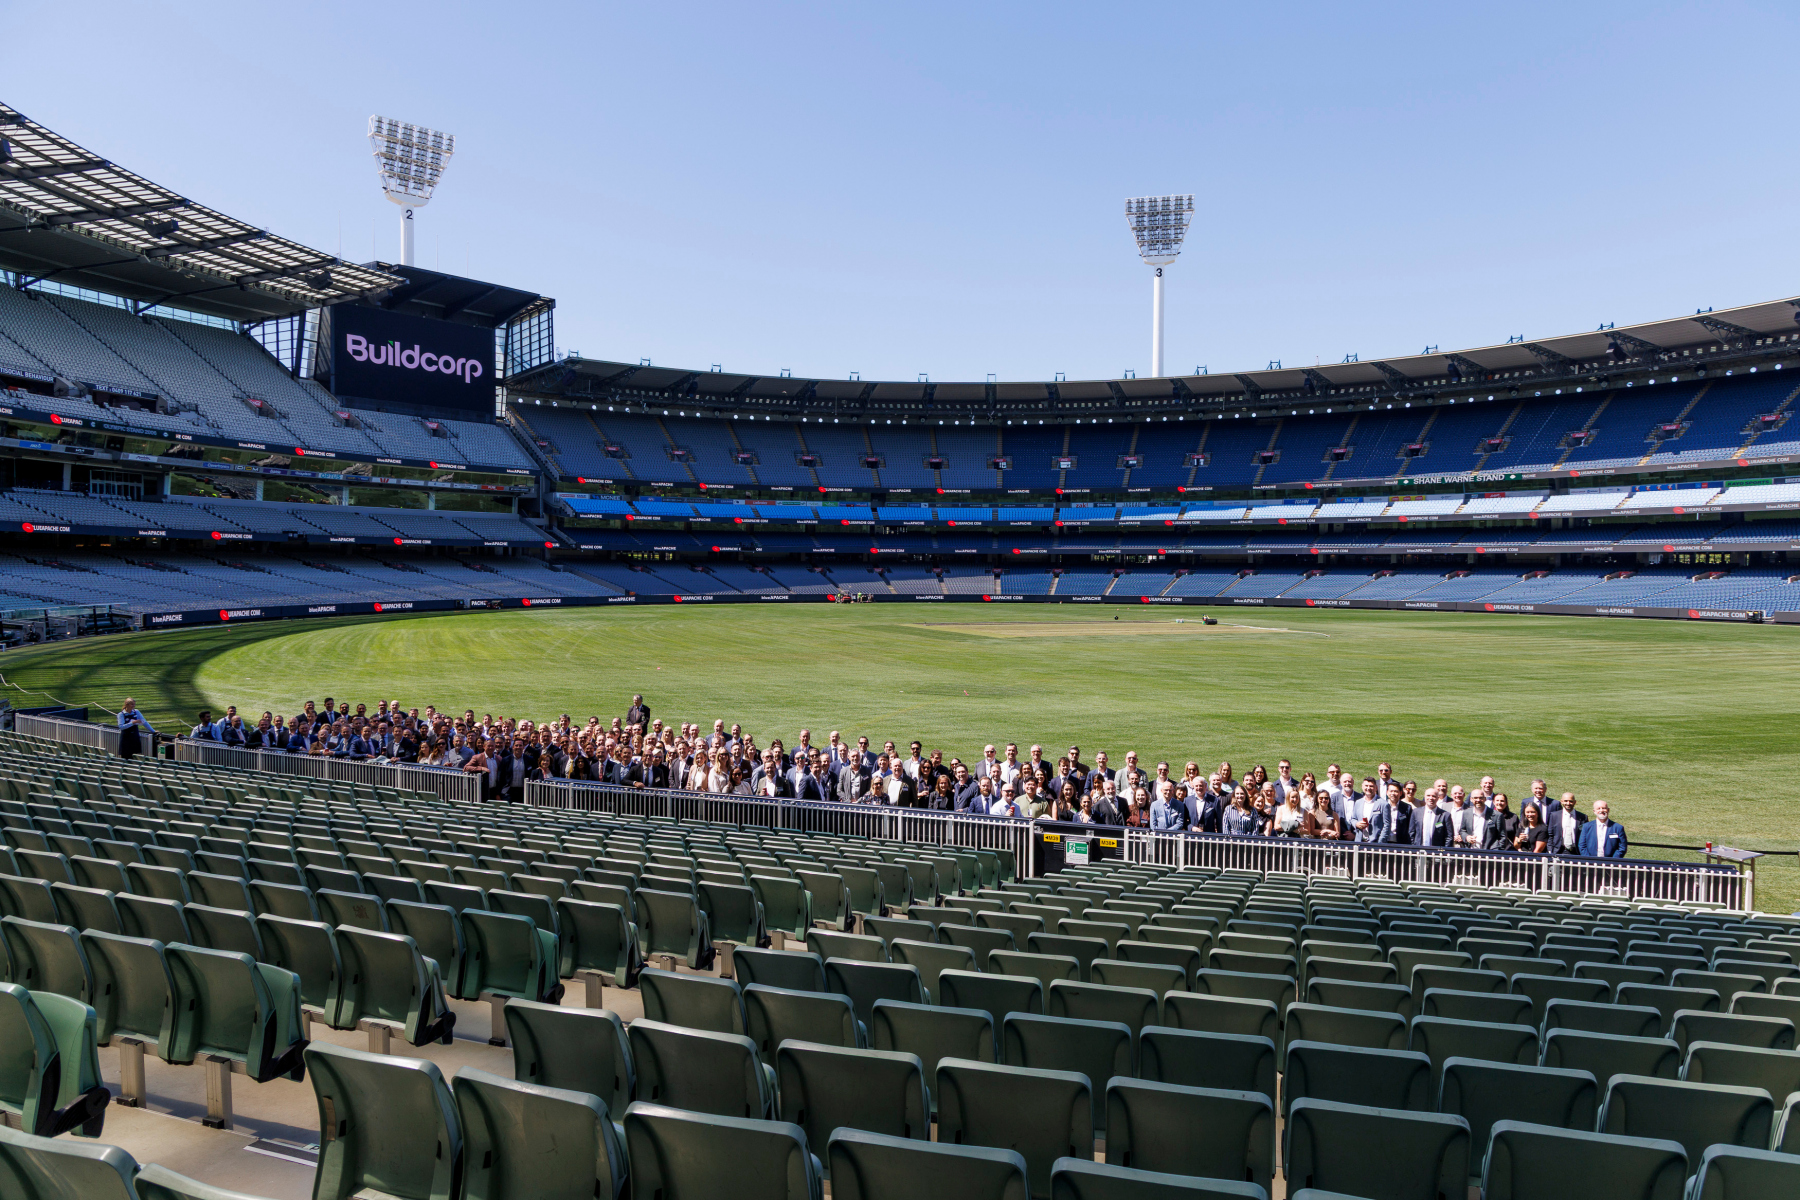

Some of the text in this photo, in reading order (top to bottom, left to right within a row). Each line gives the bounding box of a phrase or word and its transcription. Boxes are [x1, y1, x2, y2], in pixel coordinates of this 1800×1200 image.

[406, 210, 413, 220] 2
[1156, 268, 1162, 277] 3
[346, 333, 483, 384] Buildcorp
[0, 367, 54, 382] TISOCIAL BEHAVIOUR
[152, 614, 182, 623] blueAPACHE
